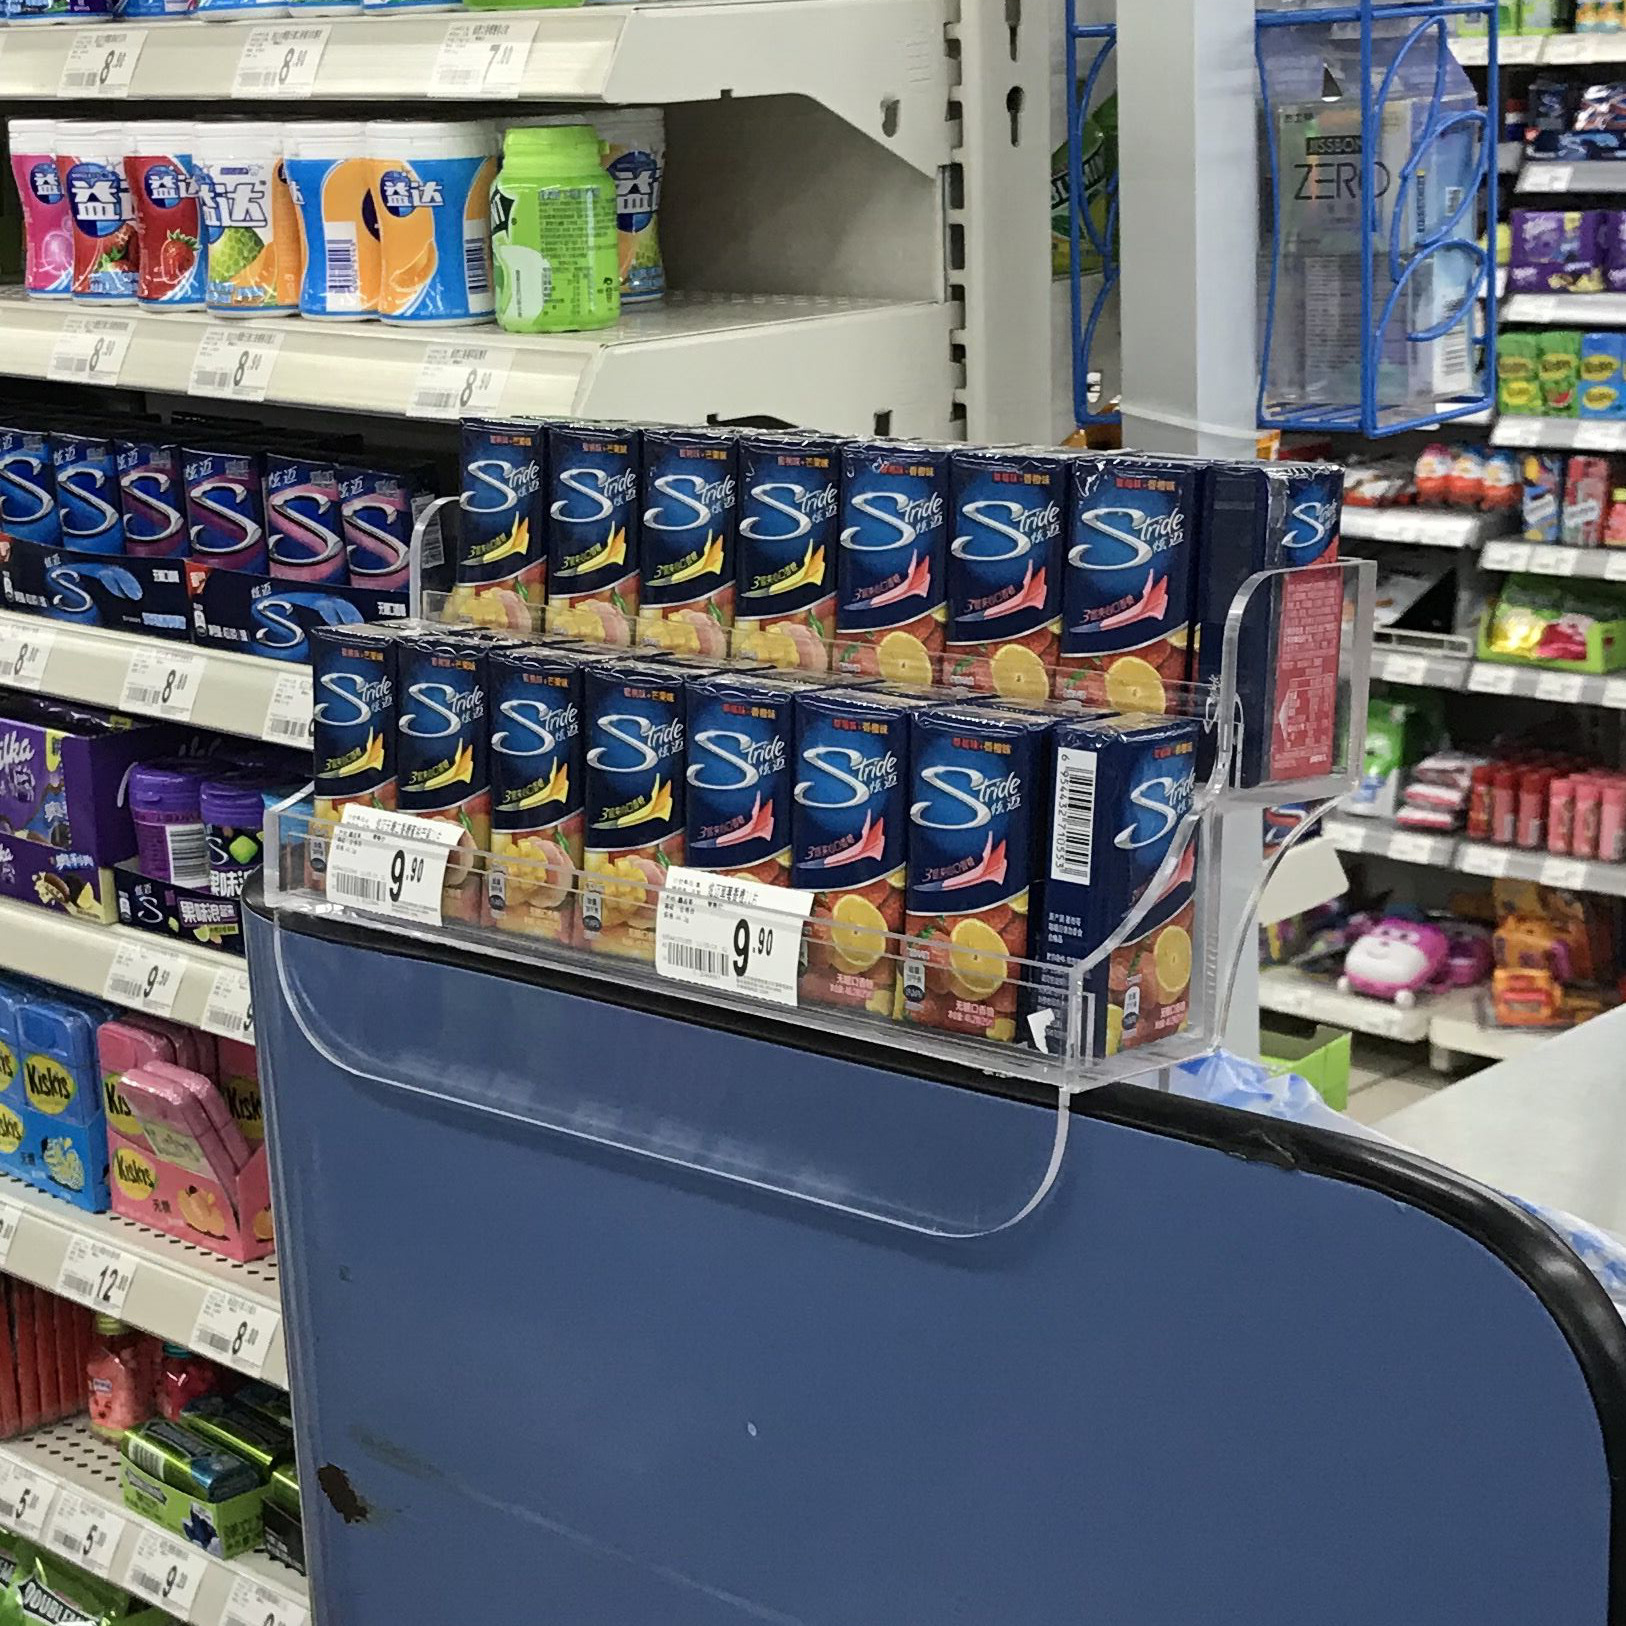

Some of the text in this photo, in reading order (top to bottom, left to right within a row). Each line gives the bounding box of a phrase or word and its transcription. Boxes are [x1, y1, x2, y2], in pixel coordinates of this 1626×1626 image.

[72, 180, 131, 220] 益
[384, 180, 444, 207] 益达
[614, 169, 661, 213] 益
[460, 459, 540, 512] Stride
[550, 467, 636, 523] Stride
[643, 474, 736, 530] Stride
[739, 483, 838, 540] Stride
[840, 491, 943, 550] Stride
[951, 500, 1060, 561] Stride
[1068, 507, 1184, 570] Stride
[314, 672, 392, 726] Stride
[399, 682, 484, 738] Stride
[491, 699, 579, 756] Stride
[587, 714, 684, 773] Stride
[686, 730, 785, 790] Stride
[794, 747, 898, 808] Stride
[1061, 753, 1070, 762] 6
[910, 765, 1021, 830] Stride
[389, 849, 425, 902] 9.90
[732, 918, 774, 977] 9.90
